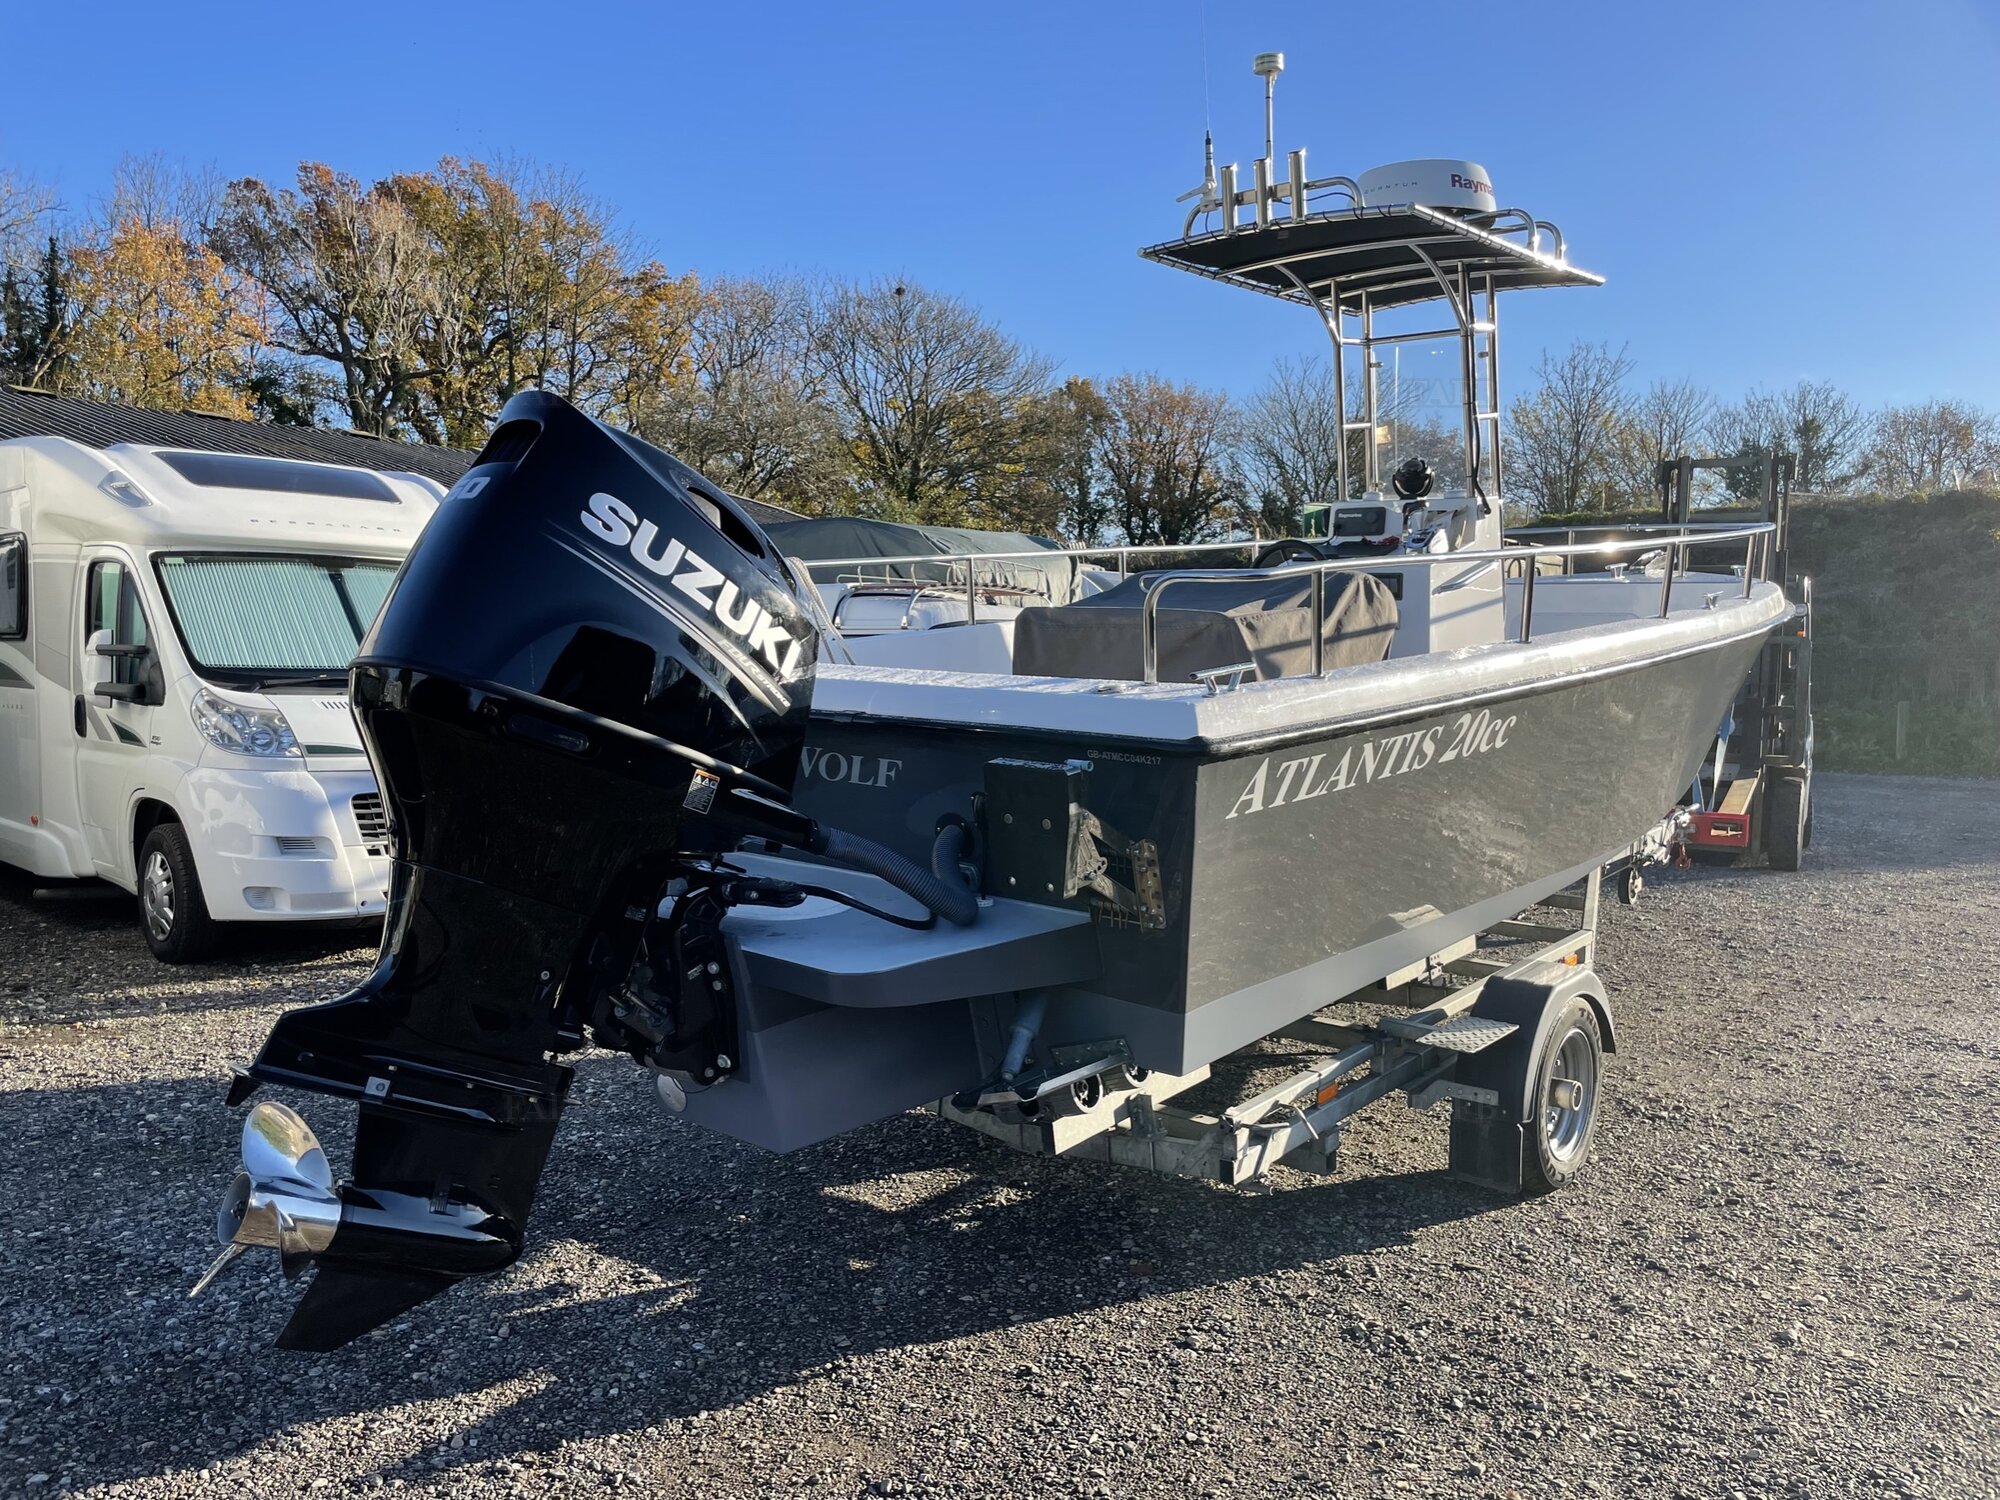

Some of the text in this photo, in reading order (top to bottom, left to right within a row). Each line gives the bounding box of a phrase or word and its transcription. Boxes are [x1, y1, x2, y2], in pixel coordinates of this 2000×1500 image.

[580, 492, 802, 678] SUZUKI
[1225, 708, 1517, 820] ATLANTIS 20cc
